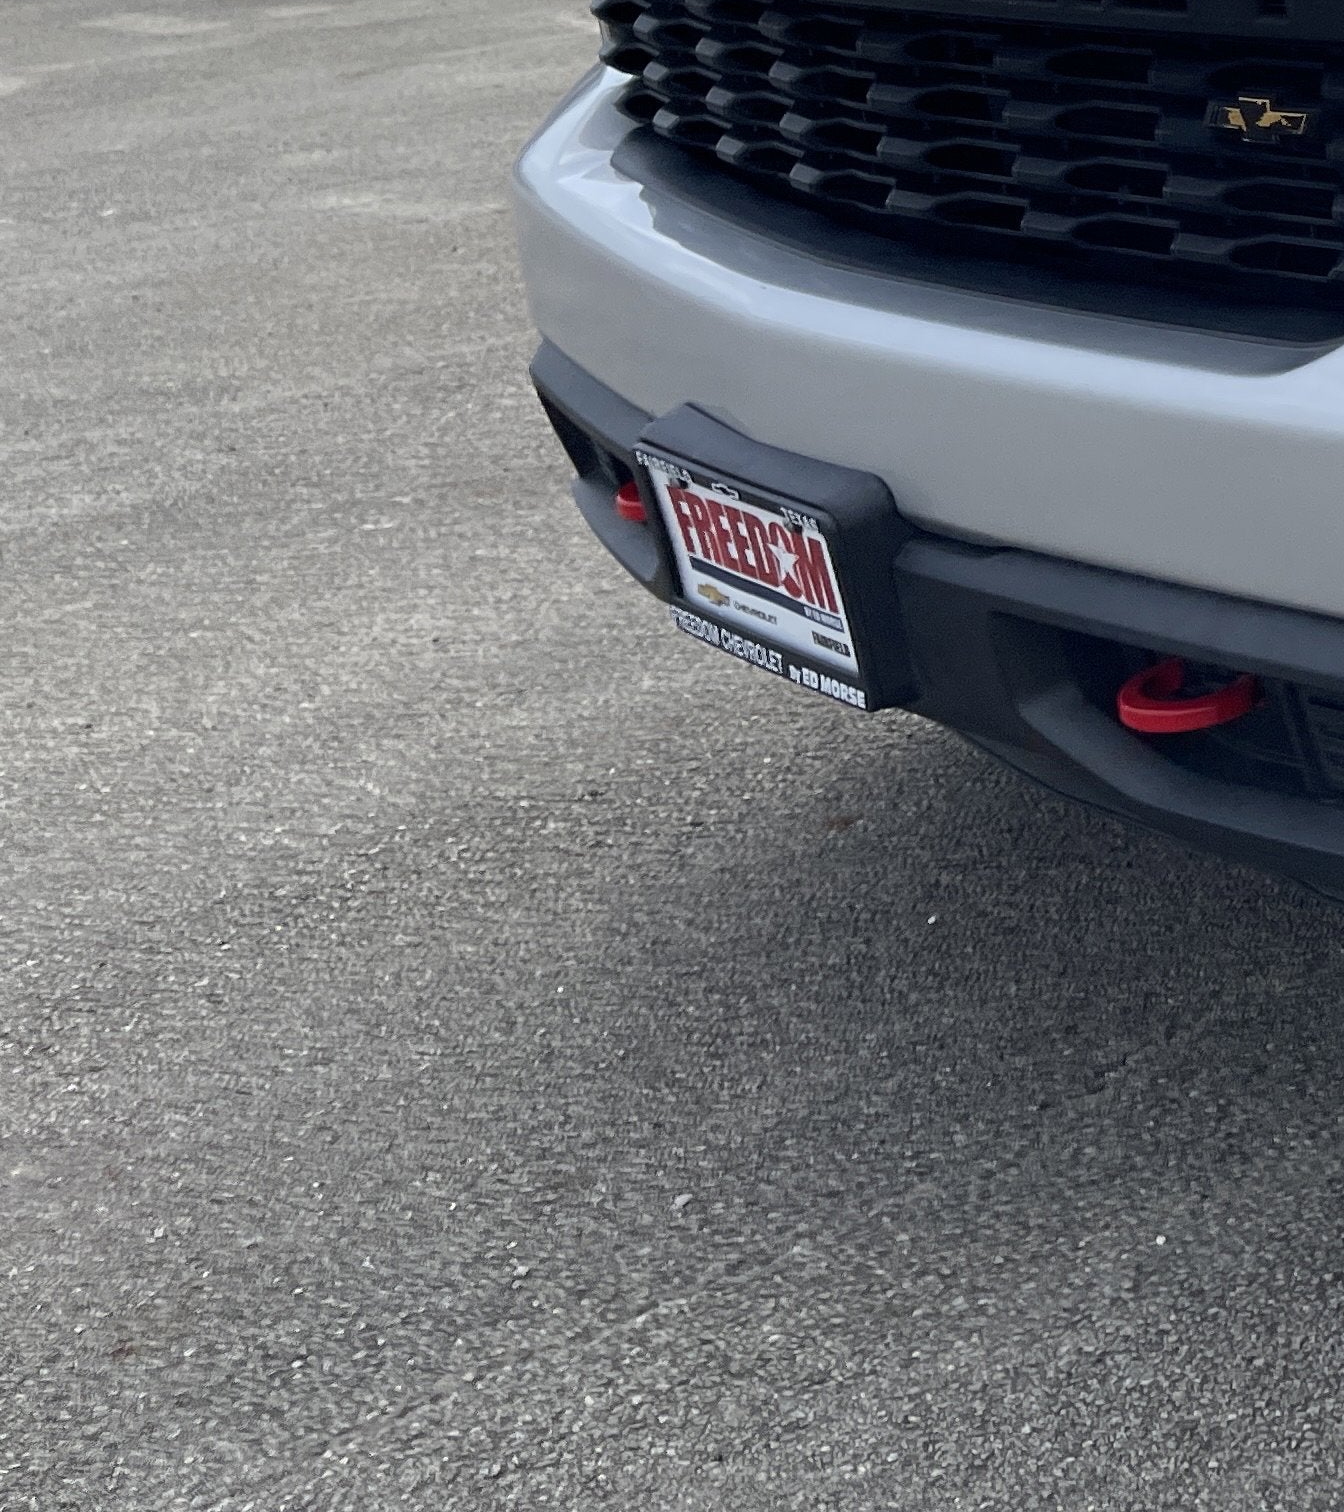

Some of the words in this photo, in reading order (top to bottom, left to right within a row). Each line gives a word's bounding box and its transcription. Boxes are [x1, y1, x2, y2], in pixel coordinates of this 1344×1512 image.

[665, 484, 840, 614] FREEDOM
[801, 666, 820, 690] ED
[819, 673, 867, 710] MORSE
